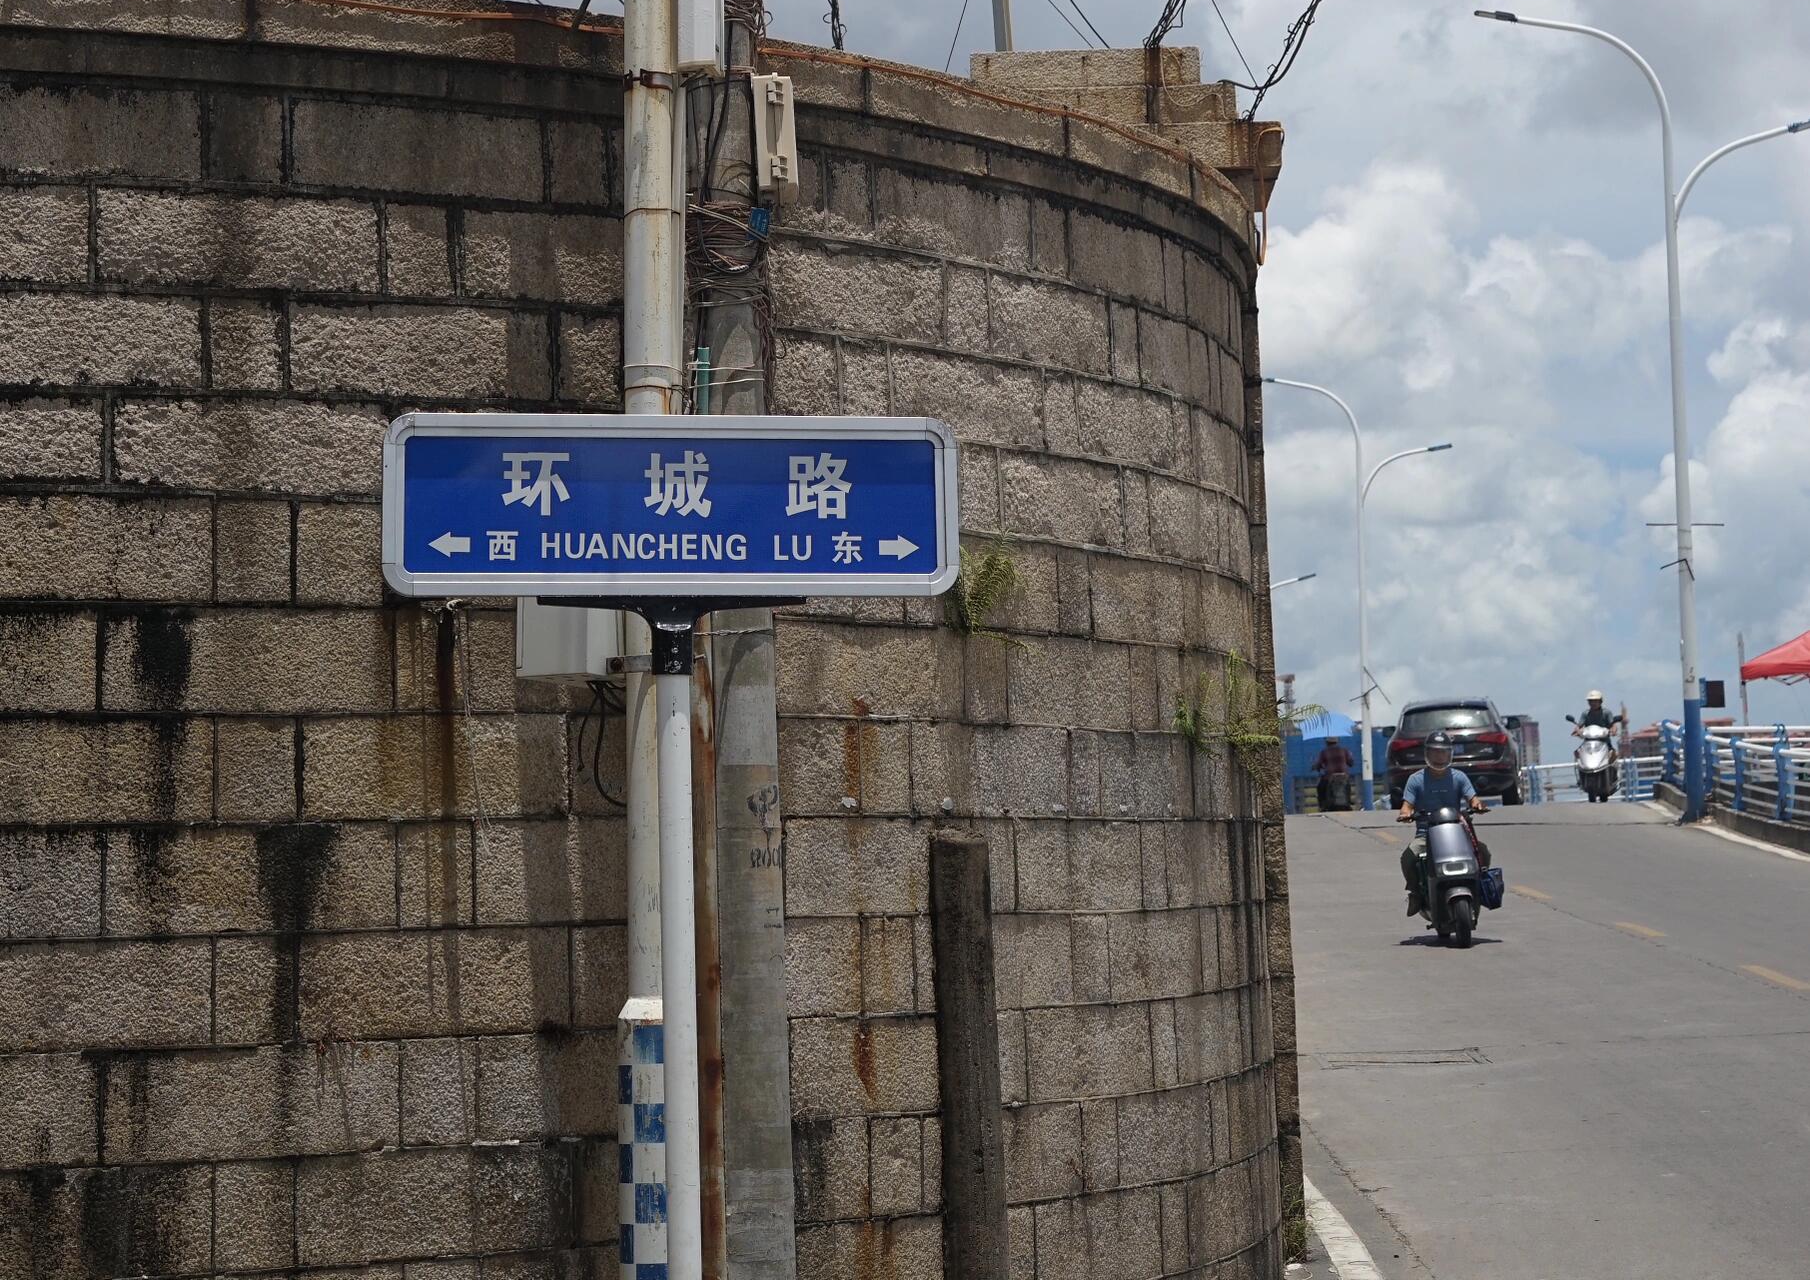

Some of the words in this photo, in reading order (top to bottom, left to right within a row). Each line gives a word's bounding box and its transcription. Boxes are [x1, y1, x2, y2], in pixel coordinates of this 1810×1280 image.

[501, 451, 853, 519] 环城路
[487, 531, 519, 561] 西
[541, 532, 747, 561] HUANCHENG
[773, 534, 812, 561] LU
[831, 531, 864, 565] 东
